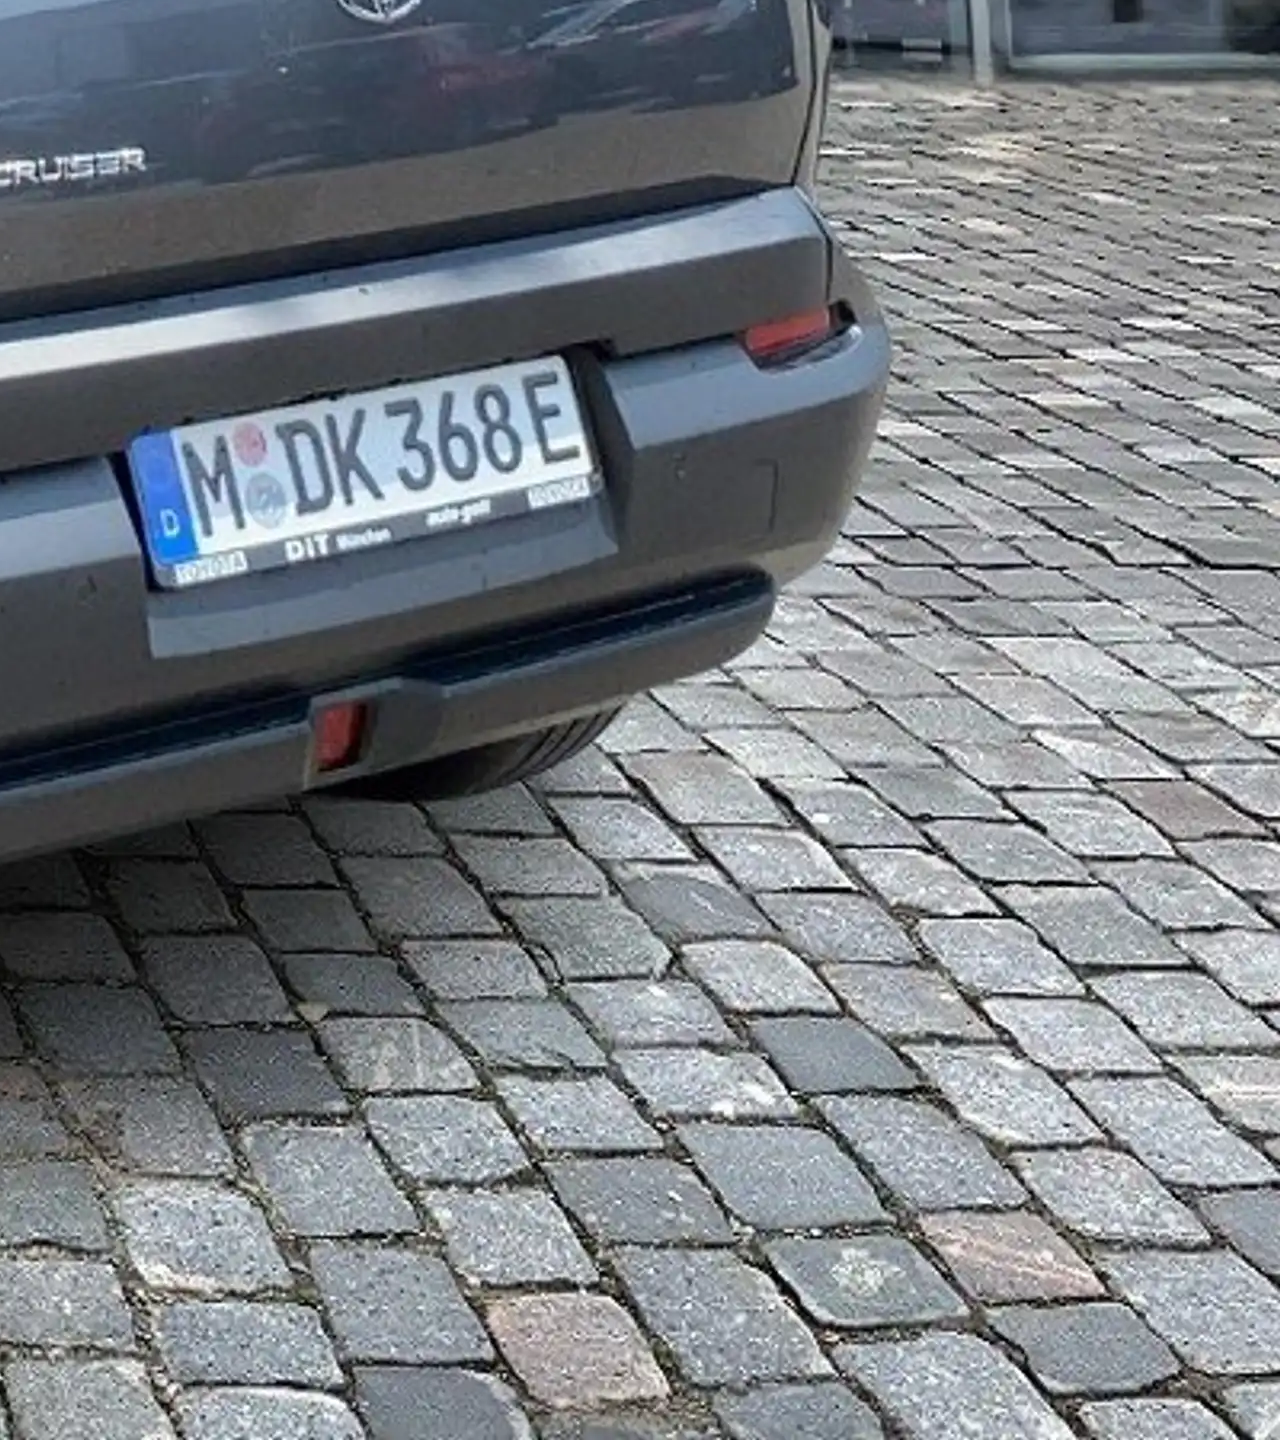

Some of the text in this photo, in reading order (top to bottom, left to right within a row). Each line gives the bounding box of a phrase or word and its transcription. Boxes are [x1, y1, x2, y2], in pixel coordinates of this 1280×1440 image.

[160, 370, 582, 538] D M DK 368E
[284, 533, 331, 561] DIT
